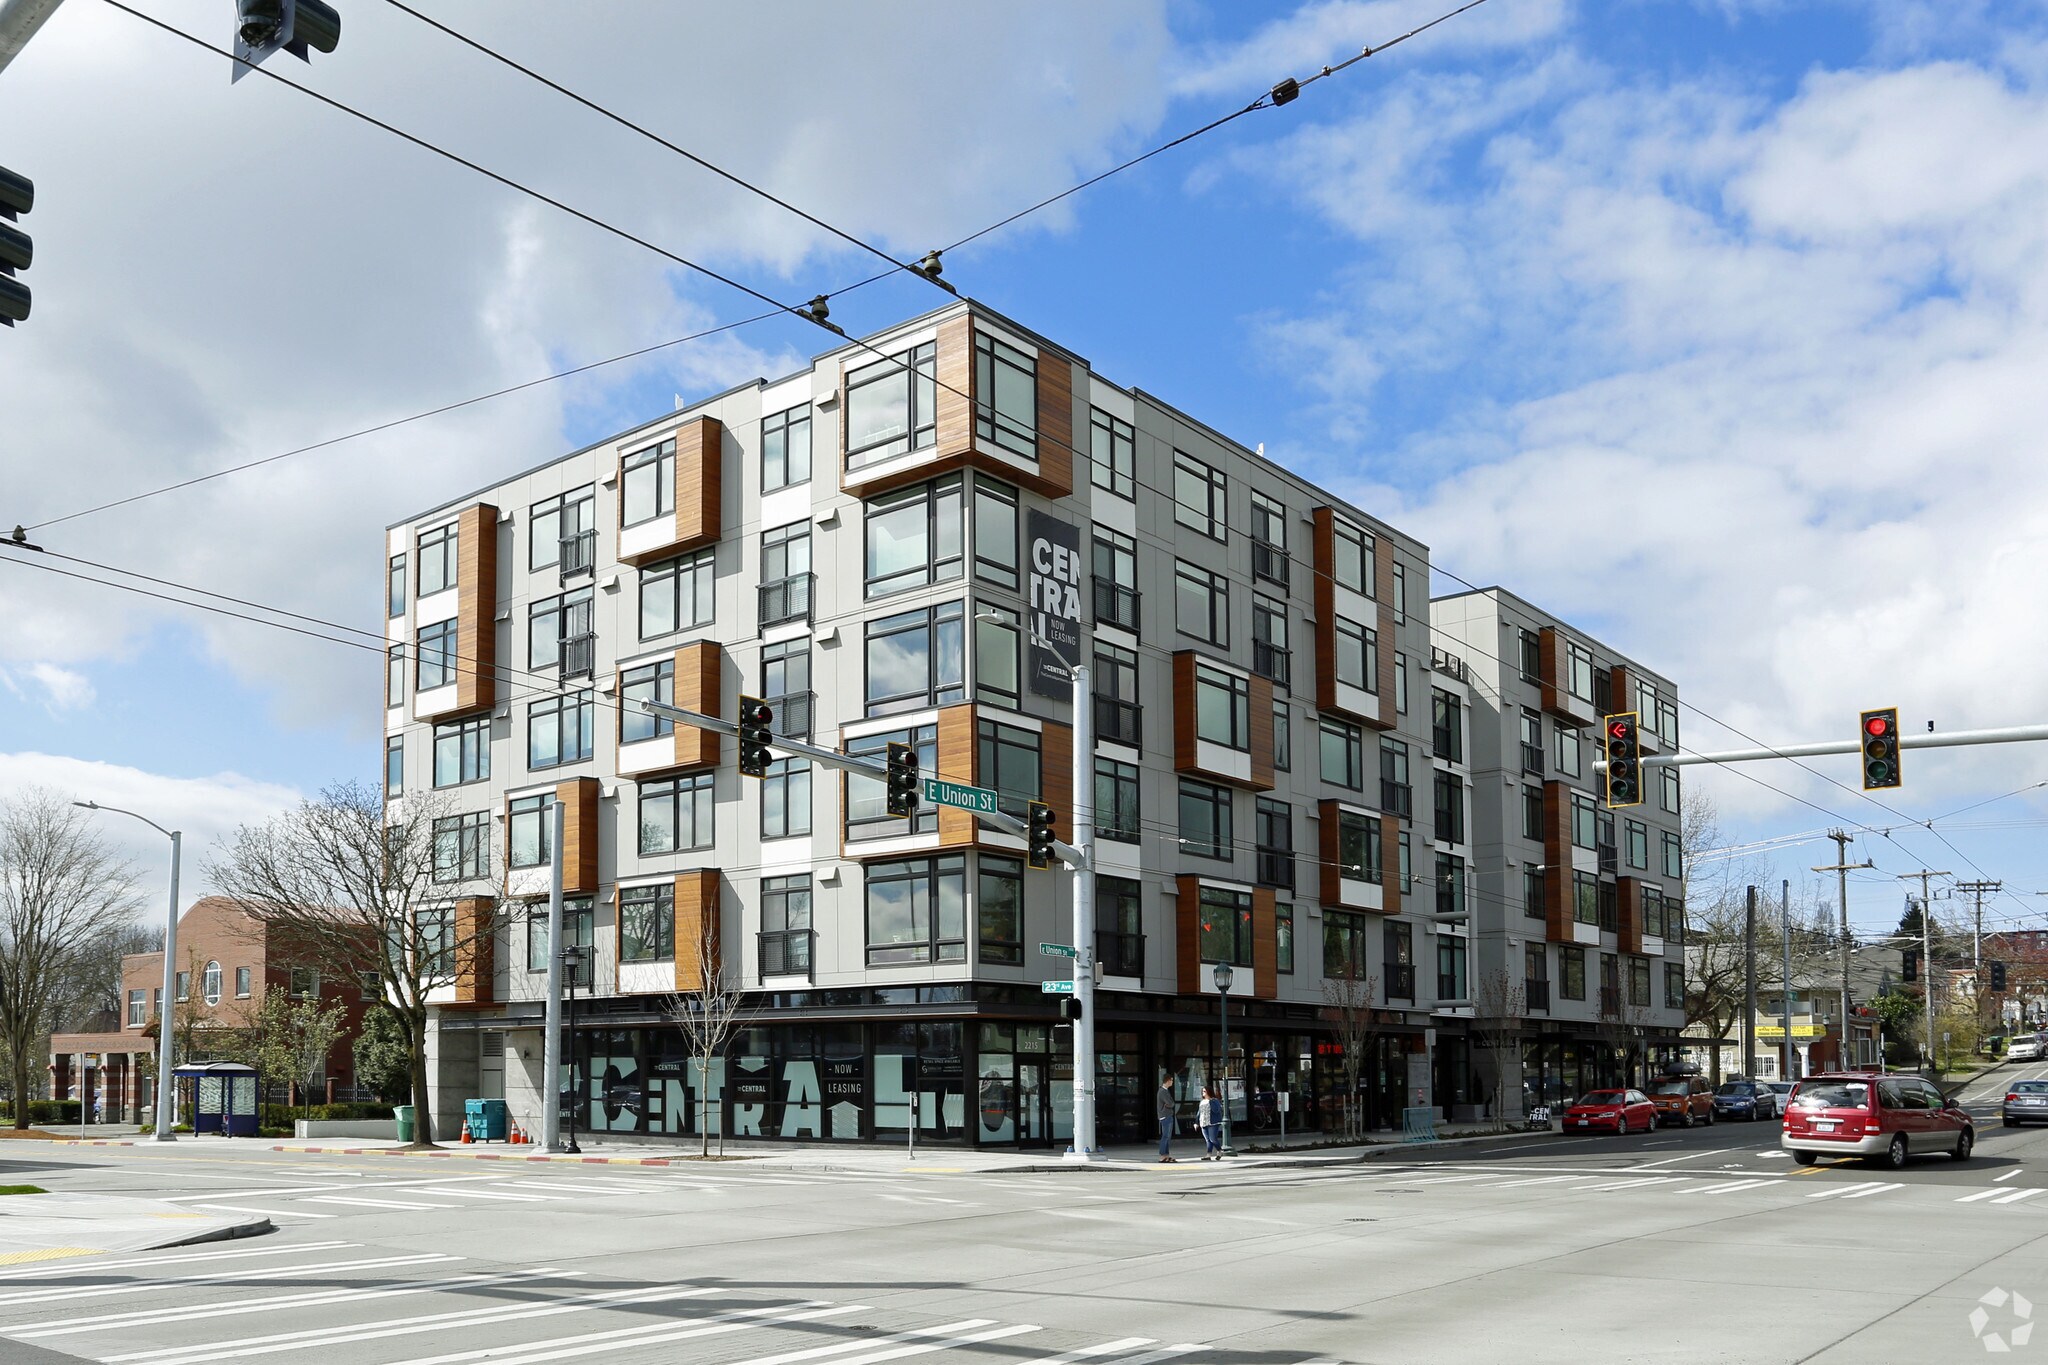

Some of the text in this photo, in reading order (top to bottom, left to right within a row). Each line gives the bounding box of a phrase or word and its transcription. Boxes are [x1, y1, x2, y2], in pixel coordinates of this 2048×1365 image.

[1032, 537, 1080, 586] CEN
[1051, 618, 1066, 631] NOW
[1051, 629, 1076, 646] LEASING
[929, 782, 993, 811] E Union St
[1046, 945, 1062, 955] Union
[1045, 983, 1060, 991] 23rd
[1024, 1041, 1038, 1050] 2215
[658, 1063, 681, 1071] CENTRAL
[834, 1064, 852, 1074] NOW
[1054, 1063, 1074, 1071] CENTRA
[741, 1085, 766, 1093] CENTRAL
[828, 1083, 862, 1094] LEASING
